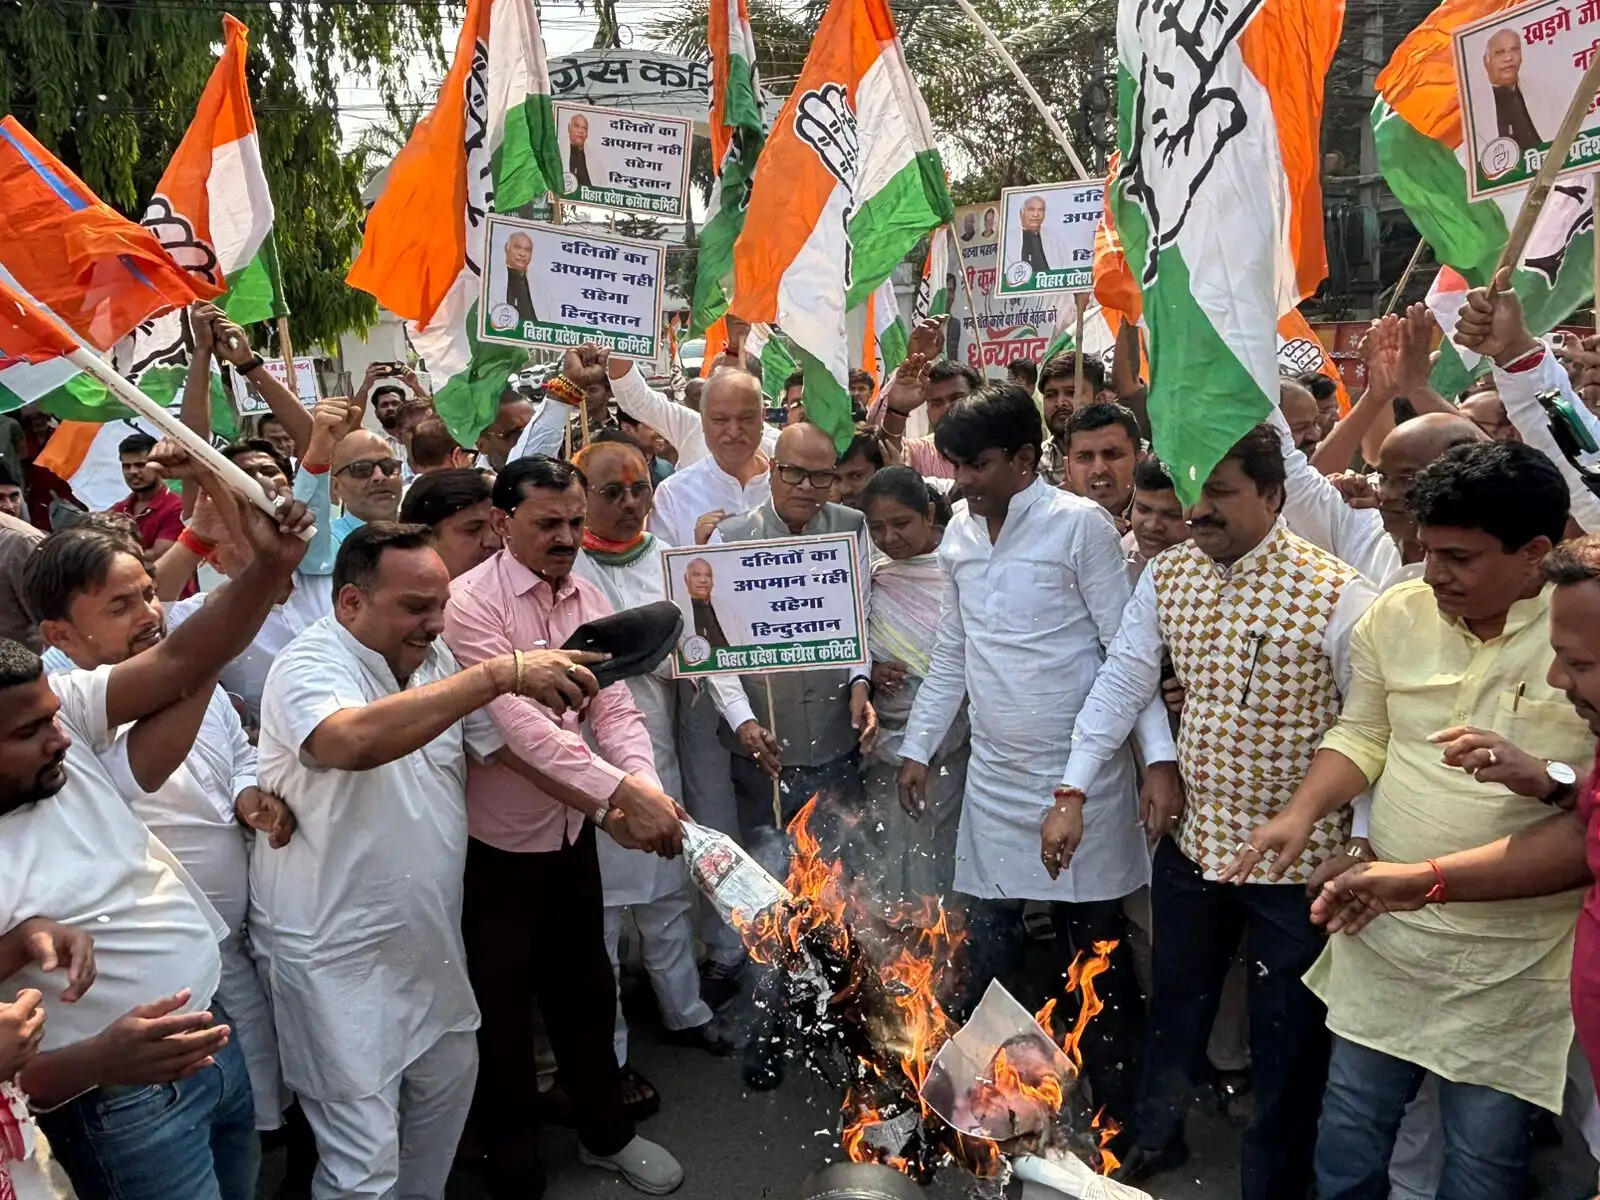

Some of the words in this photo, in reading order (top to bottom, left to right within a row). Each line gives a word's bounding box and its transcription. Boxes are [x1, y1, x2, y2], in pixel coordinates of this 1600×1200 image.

[549, 58, 632, 95] ग्रेस
[609, 119, 655, 136] दलितों
[658, 125, 677, 138] का
[601, 136, 652, 152] अपमान
[624, 157, 663, 172] सहेगा
[609, 172, 671, 190] हिन्दुस्तान
[581, 186, 602, 202] बिहार
[603, 190, 624, 206] प्रदेश
[651, 197, 680, 214] कमिटी
[561, 241, 620, 261] दलितों
[624, 251, 649, 266] का
[550, 261, 618, 283] अपमान
[1035, 272, 1065, 289] बिहार
[581, 287, 630, 305] सहेगा
[560, 304, 643, 328] हिन्दुस्तान
[522, 320, 553, 341] बिहार
[554, 325, 581, 345] प्रदेश
[617, 336, 652, 355] कमिटी
[740, 549, 805, 568] दलितों
[809, 548, 838, 564] का
[734, 574, 809, 592] अपमान
[768, 597, 825, 612] सहेगा
[751, 618, 842, 639] हिन्दुस्तान
[715, 650, 748, 669] बिहार
[749, 646, 778, 667] प्रदेश
[817, 638, 857, 660] कमिटी
